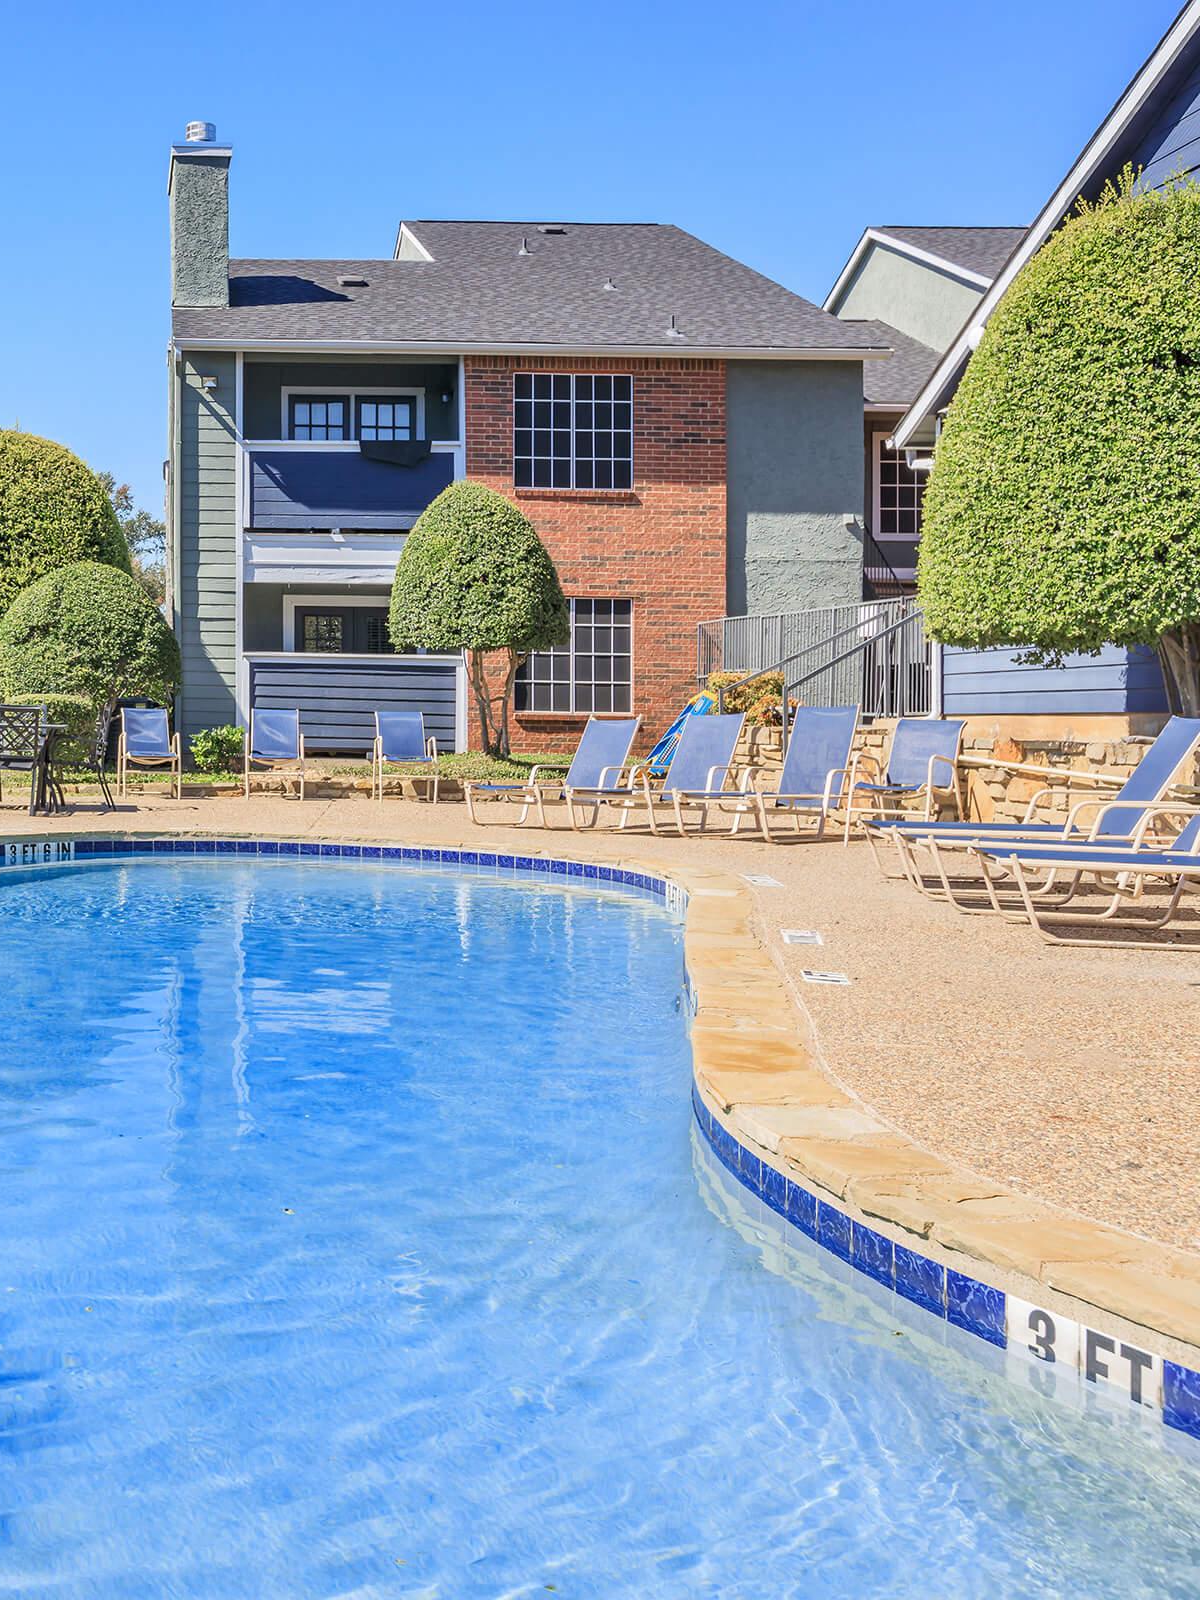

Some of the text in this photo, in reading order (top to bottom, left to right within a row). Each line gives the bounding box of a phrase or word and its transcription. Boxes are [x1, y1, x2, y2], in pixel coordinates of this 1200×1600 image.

[10, 842, 71, 857] 3 FT 6 IN
[1028, 1309, 1056, 1363] 3
